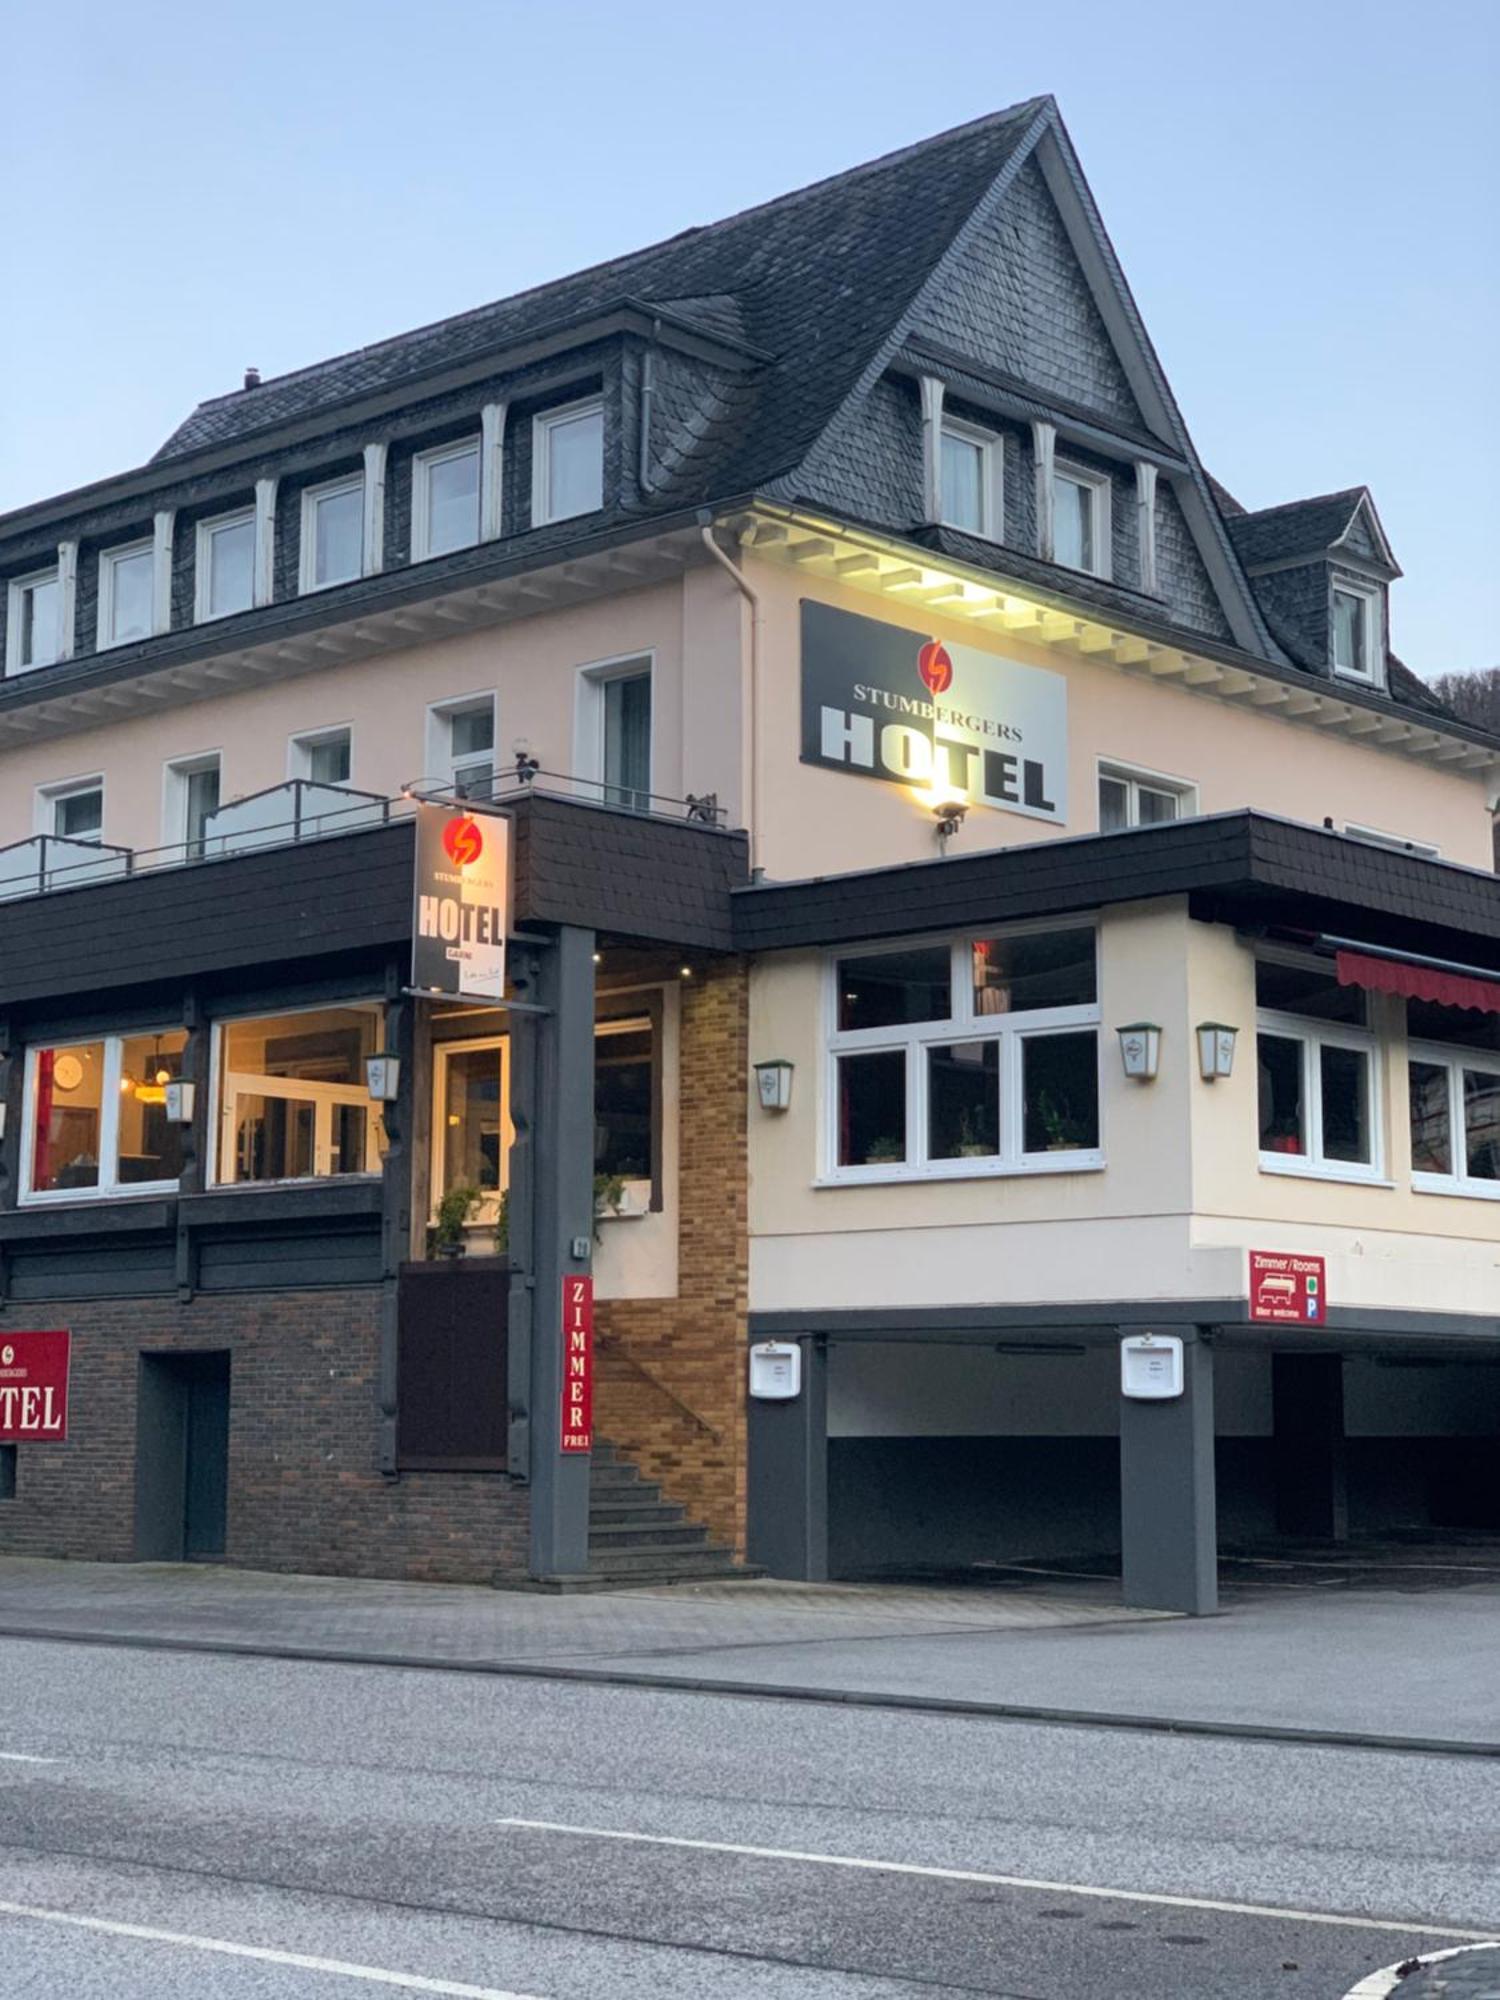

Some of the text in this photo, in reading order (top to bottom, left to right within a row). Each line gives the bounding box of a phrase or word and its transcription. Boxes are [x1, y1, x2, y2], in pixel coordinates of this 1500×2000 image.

[853, 683, 1023, 742] STUMBERGERS
[820, 706, 1056, 812] HOTEL
[418, 895, 503, 947] HOTEL
[1307, 1298, 1317, 1317] P
[570, 1282, 587, 1428] ZIMMER
[563, 1434, 589, 1447] FREI
